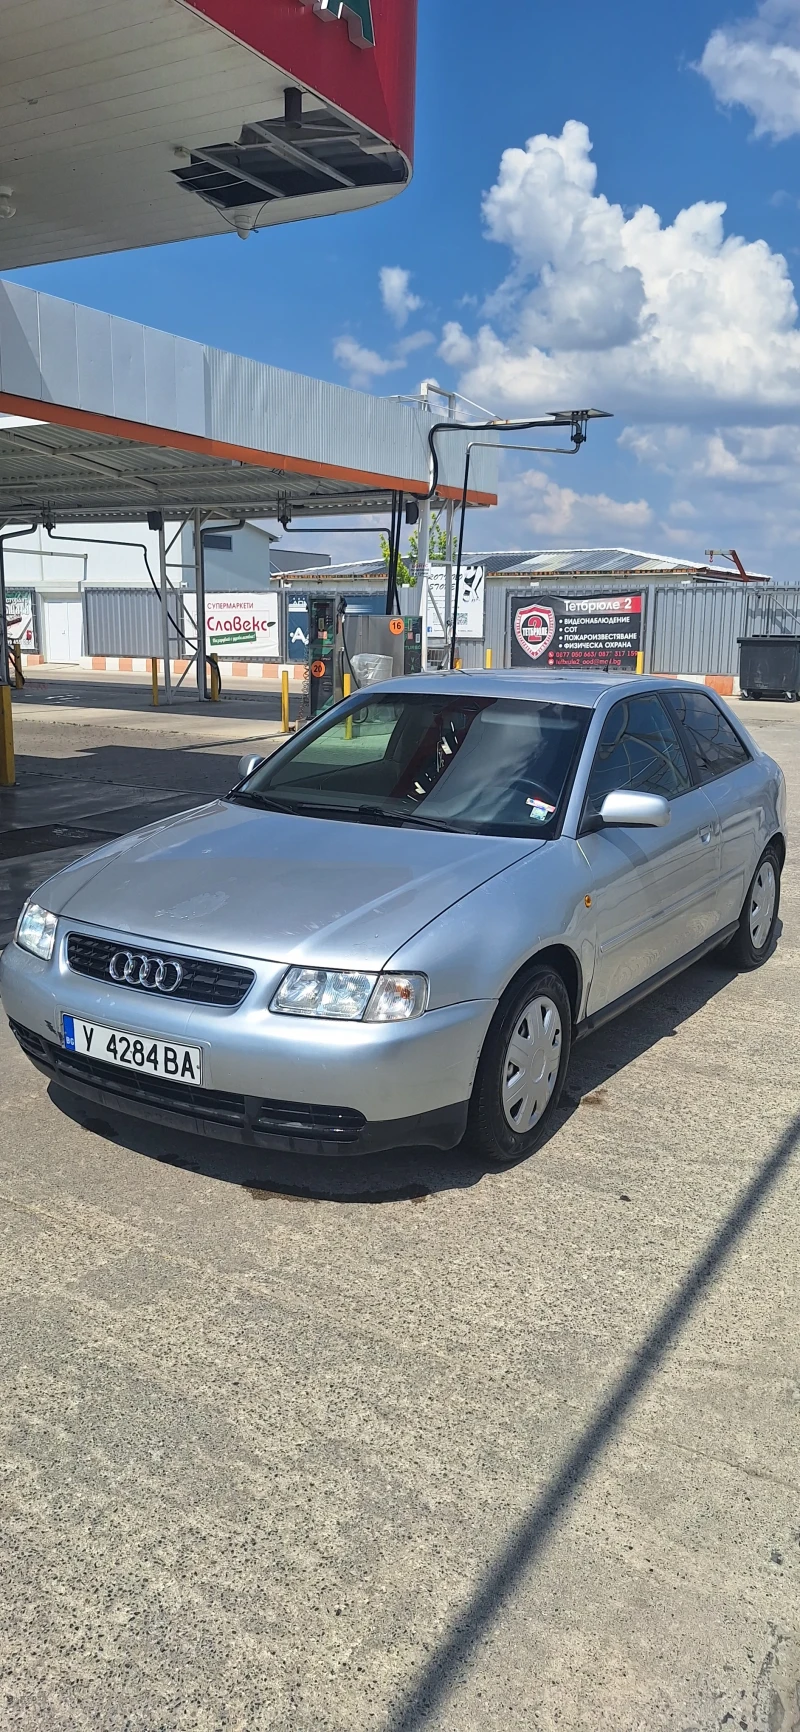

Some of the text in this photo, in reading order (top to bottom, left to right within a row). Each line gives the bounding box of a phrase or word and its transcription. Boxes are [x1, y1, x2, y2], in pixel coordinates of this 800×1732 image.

[429, 583, 456, 591] STOE
[563, 598, 632, 613] Тетбрюле 2
[564, 616, 630, 625] ВИДЕОНАБЛЮДЕНИЕ
[392, 621, 401, 630] 16
[564, 633, 637, 641] ПОЖАРОИЗВЕСТЯВАНЕ
[313, 664, 322, 672] 20
[66, 1036, 75, 1045] BG
